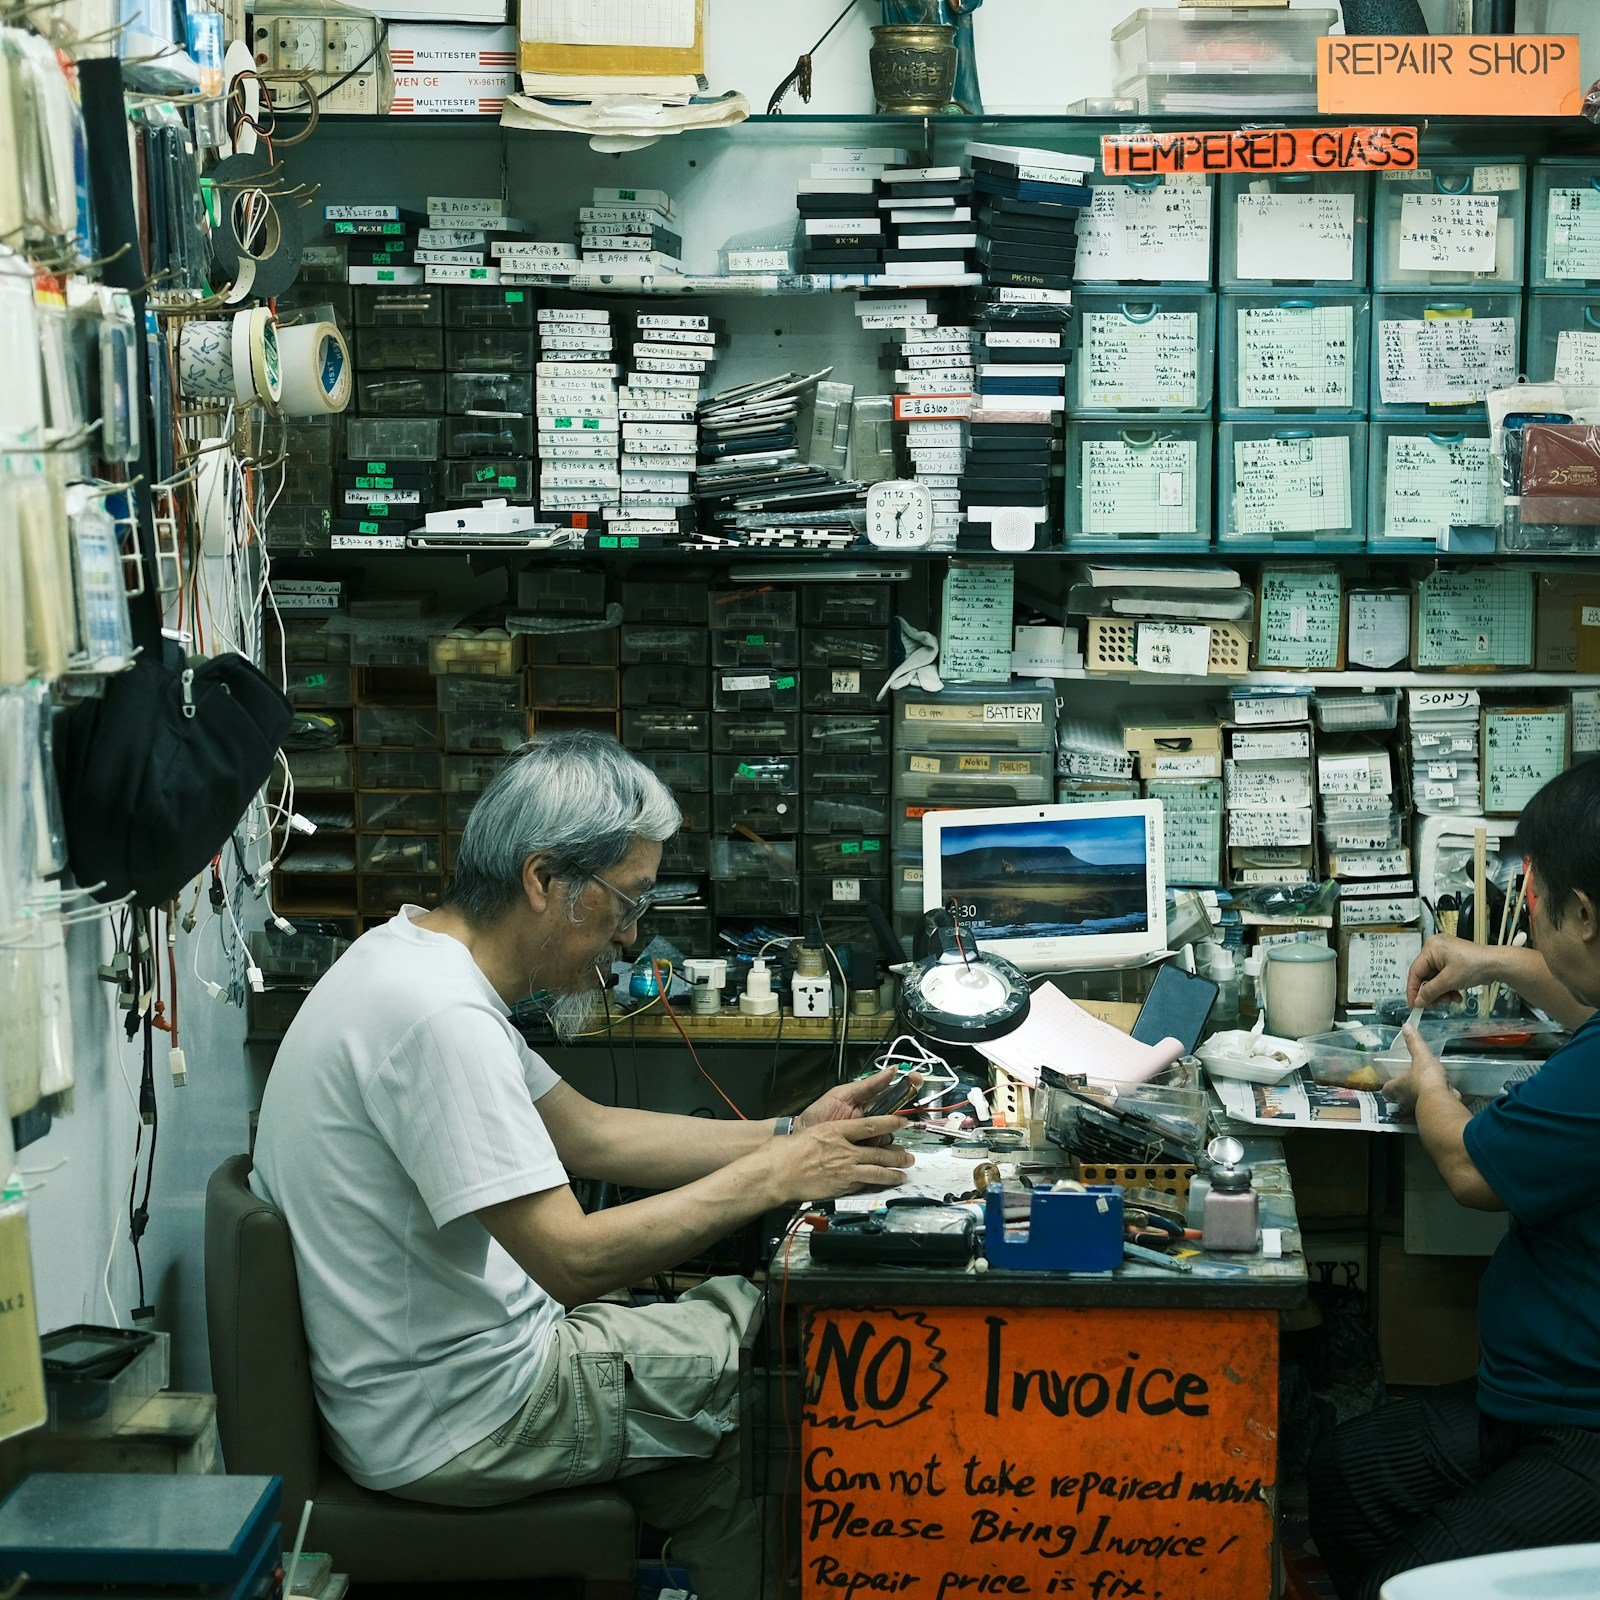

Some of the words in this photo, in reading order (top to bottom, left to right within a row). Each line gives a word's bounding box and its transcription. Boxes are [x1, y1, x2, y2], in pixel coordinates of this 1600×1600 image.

[416, 51, 477, 60] MULTITESTER
[1328, 42, 1453, 75] REPAIR
[1469, 42, 1566, 76] SHOP
[423, 78, 439, 87] GE
[468, 78, 506, 87] YX-961TR
[416, 99, 476, 107] MULTITESTER
[1104, 132, 1297, 172] TEMPERED
[1312, 131, 1416, 167] GLASS
[357, 225, 382, 233] PK-XR
[1031, 275, 1044, 284] Pro
[883, 491, 891, 499] 11
[876, 499, 885, 508] 10
[916, 498, 923, 507] 2
[875, 512, 881, 520] 9
[917, 511, 923, 520] 3
[875, 523, 882, 532] 8
[884, 530, 890, 539] 7
[909, 530, 915, 539] 5
[1419, 692, 1469, 708] SONY
[986, 705, 1041, 721] BATTERY
[964, 758, 989, 767] Nokia
[999, 762, 1029, 772] PHILIPS
[813, 1318, 912, 1412] NO
[984, 1316, 1210, 1418] Invoice
[963, 1453, 1036, 1497] take
[1050, 1471, 1192, 1513] repaired
[808, 1499, 945, 1542] Please
[970, 1508, 1077, 1559] Bring
[810, 1554, 920, 1600] Repair
[937, 1563, 1032, 1600] price
[1046, 1569, 1073, 1597] is
